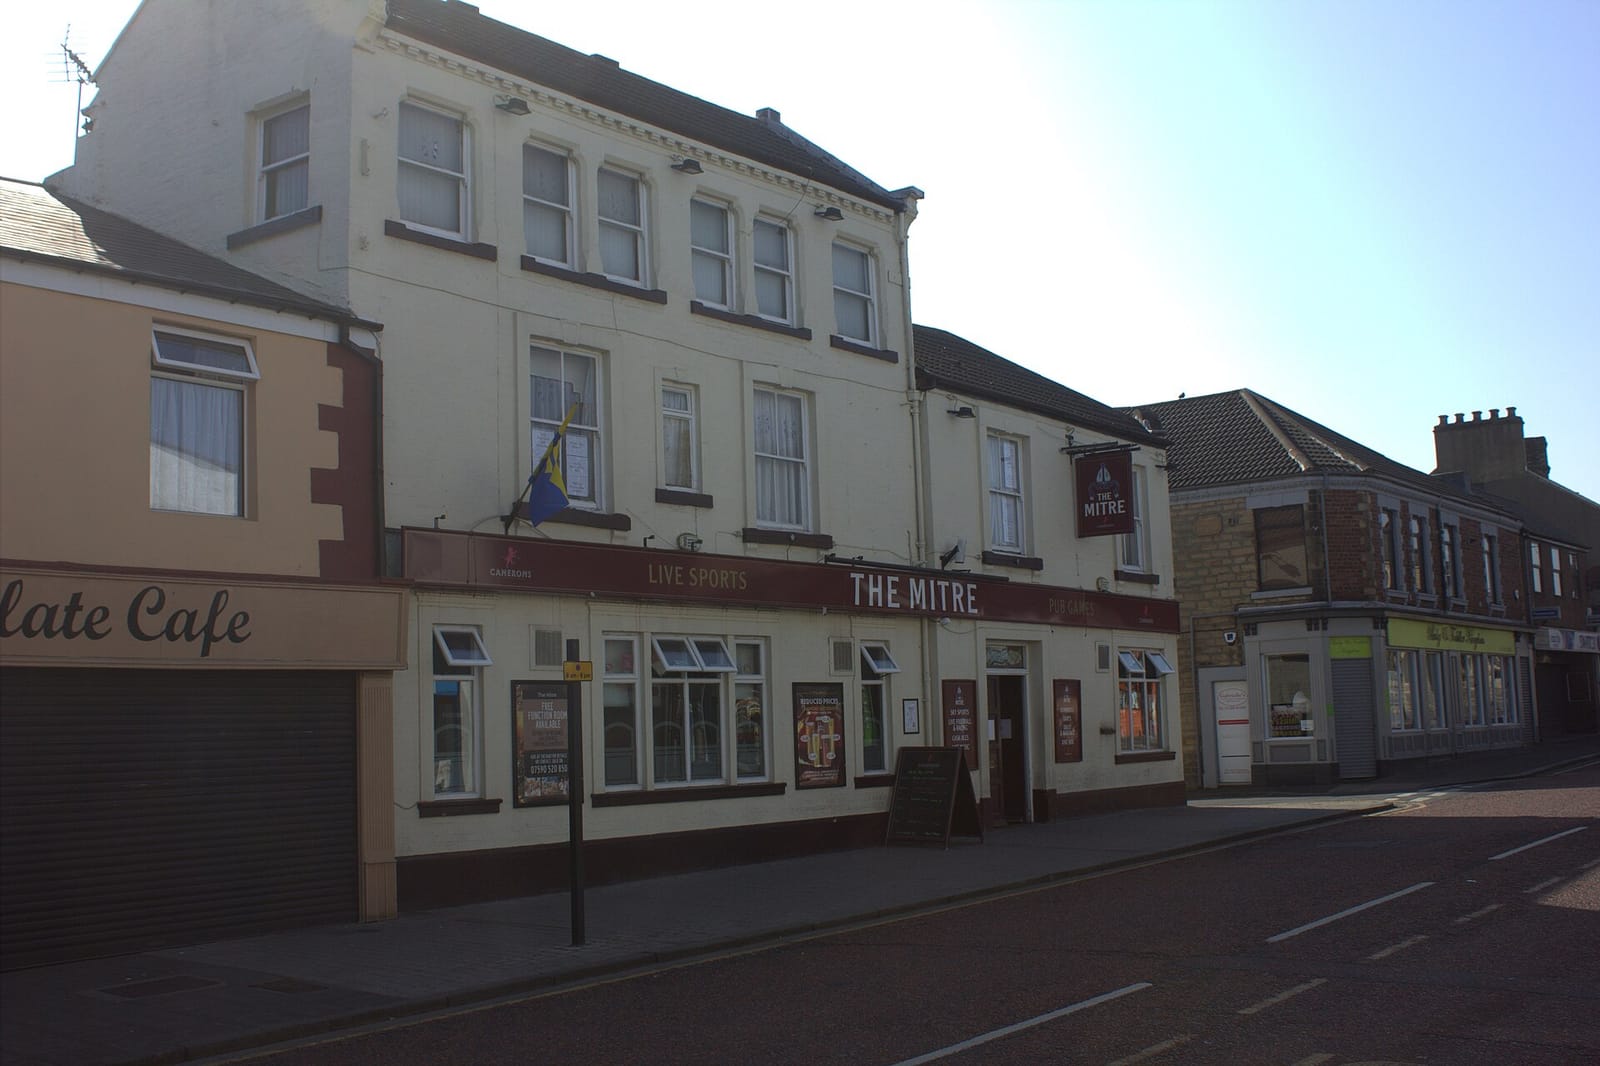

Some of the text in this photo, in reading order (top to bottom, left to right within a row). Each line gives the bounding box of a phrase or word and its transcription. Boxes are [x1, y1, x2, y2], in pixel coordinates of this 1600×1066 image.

[1097, 492, 1112, 501] THE
[1084, 500, 1126, 517] MITRE
[490, 568, 532, 579] CAMERONS
[649, 563, 748, 591] LIVE SPORTS
[850, 572, 978, 614] THE MITRE
[127, 585, 252, 658] Cafe
